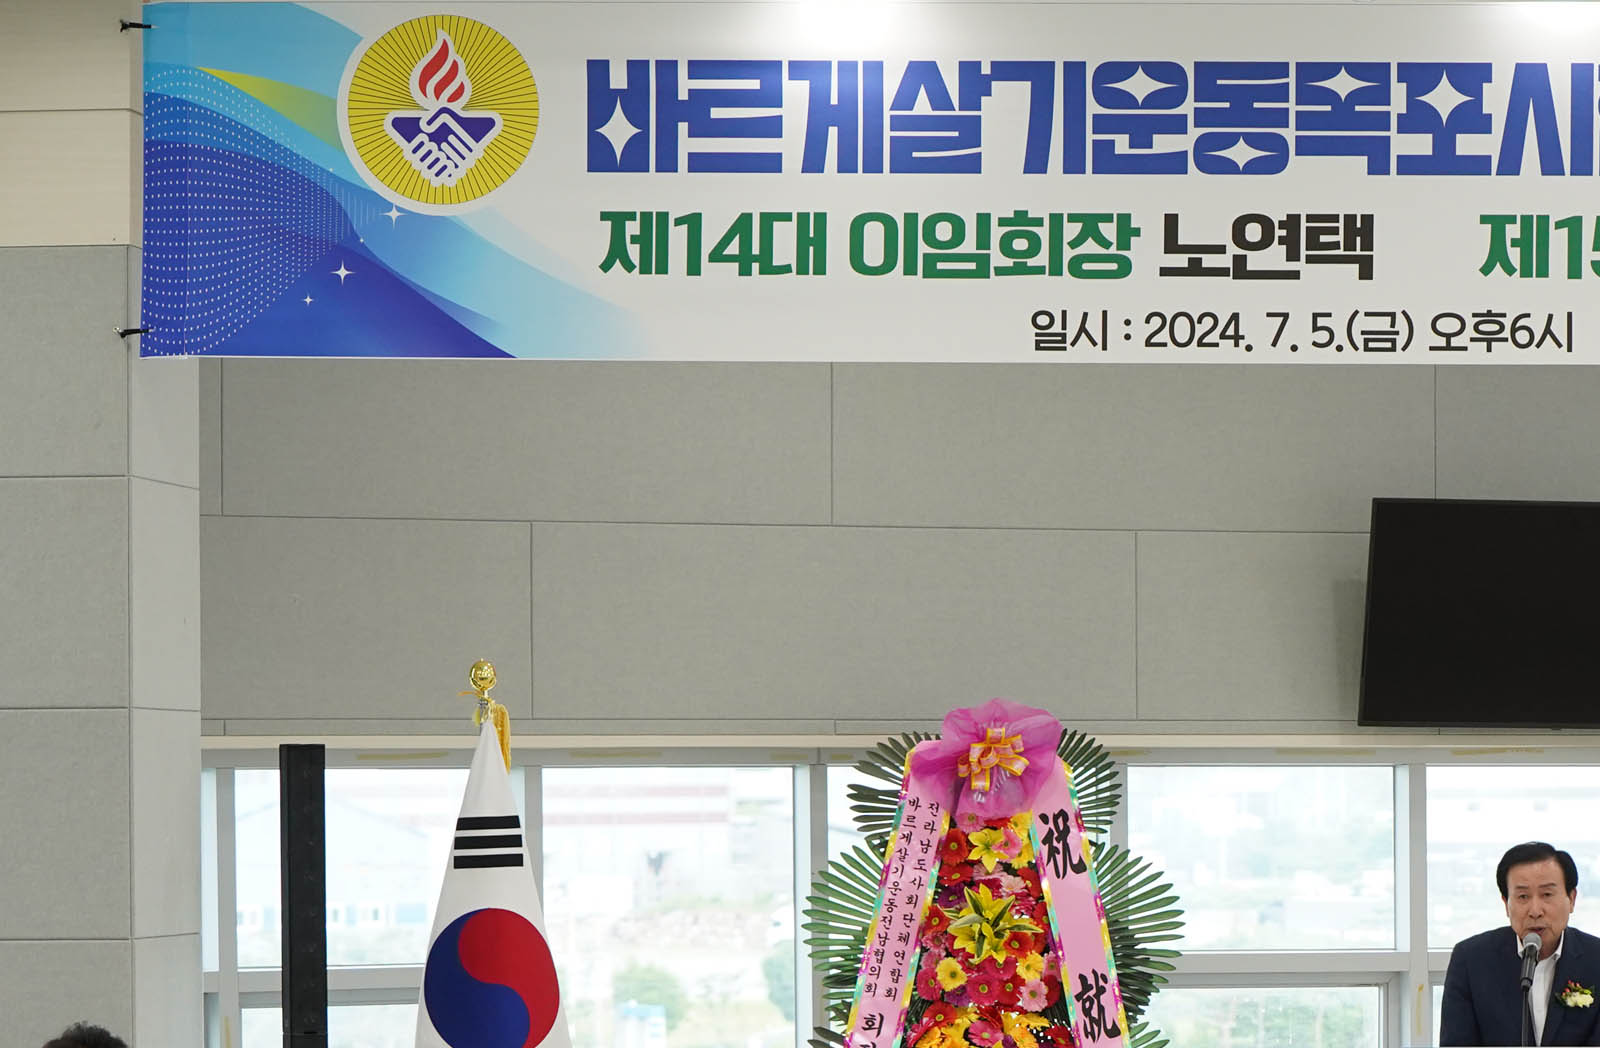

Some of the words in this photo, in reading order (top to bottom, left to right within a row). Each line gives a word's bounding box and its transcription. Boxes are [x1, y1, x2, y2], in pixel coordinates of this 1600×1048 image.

[599, 211, 827, 276] 제14대
[850, 210, 1141, 279] 이임회장
[1159, 214, 1374, 280] 노연택
[1031, 310, 1109, 352] 일시
[1145, 312, 1253, 352] 2024.
[1266, 312, 1298, 352] 7.
[1312, 310, 1414, 353] 5.(금)
[1429, 310, 1574, 353] 오후6시
